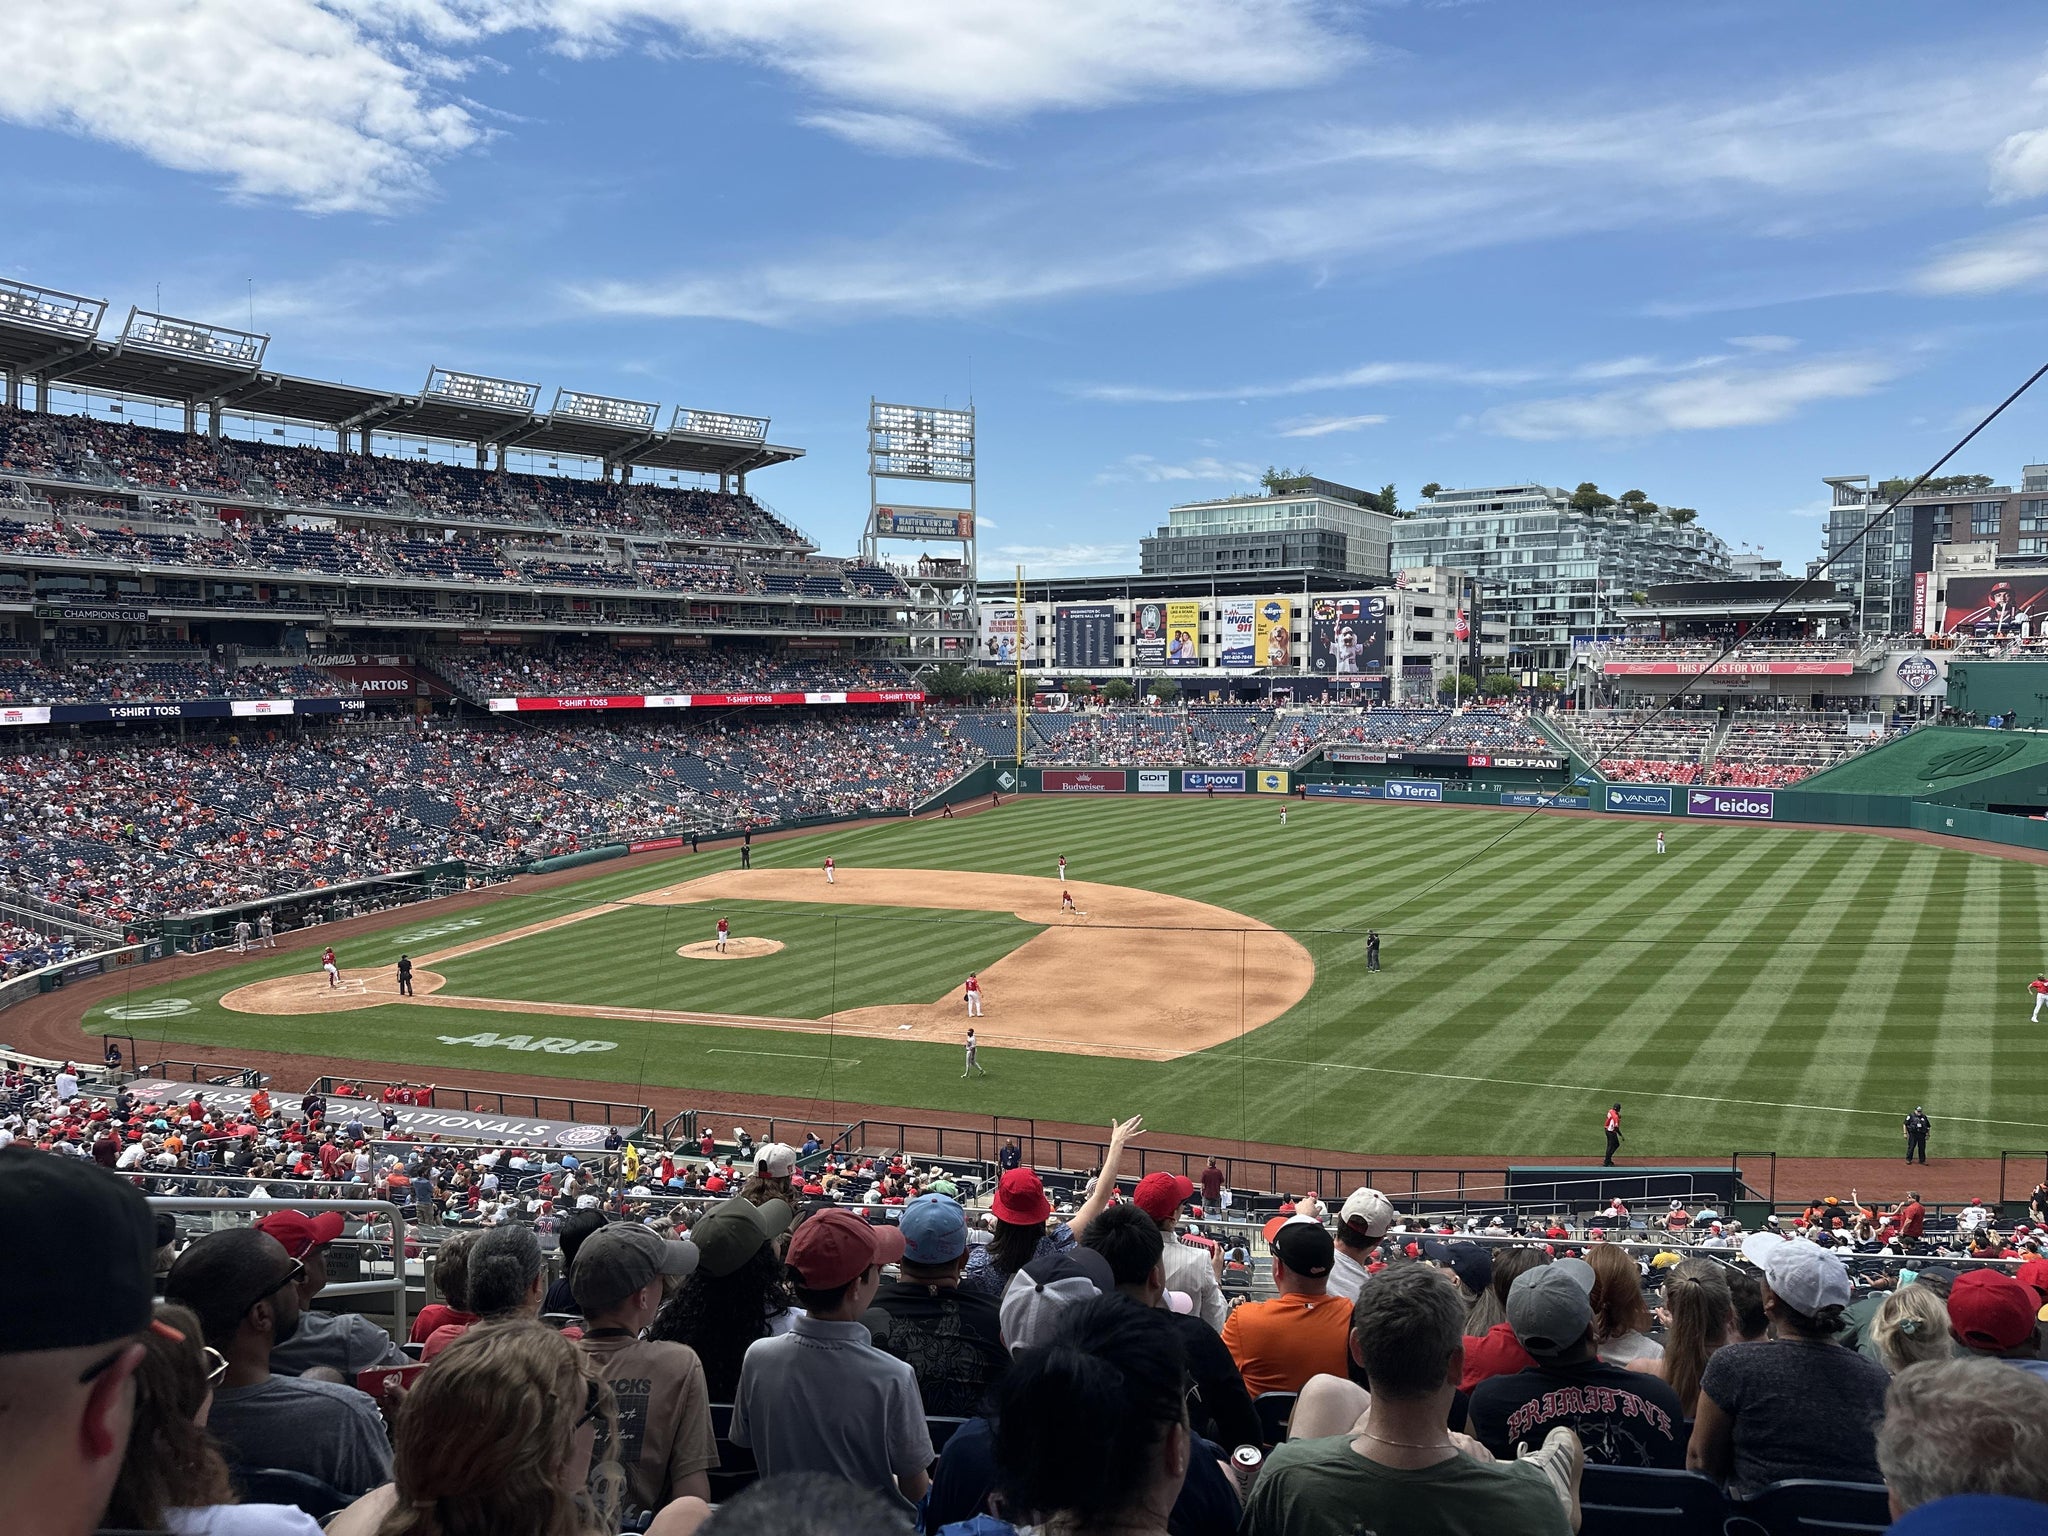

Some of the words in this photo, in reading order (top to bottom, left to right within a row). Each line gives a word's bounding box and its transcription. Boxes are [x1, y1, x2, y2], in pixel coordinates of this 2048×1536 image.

[898, 517, 925, 527] BEAUTIFUL
[926, 519, 942, 527] VIEWS
[942, 520, 953, 528] AND
[896, 525, 915, 533] AWARD
[915, 526, 938, 535] WINNING
[938, 527, 956, 536] BREWS
[1915, 584, 1924, 605] TEAM
[64, 609, 120, 620] CHAMPIONS
[122, 610, 146, 620] CLUB
[1227, 615, 1253, 624] HVAC
[1915, 606, 1924, 630] STORE
[1237, 624, 1252, 632] 911
[1676, 664, 1697, 673] THIS
[1729, 664, 1748, 673] FOR
[1750, 663, 1772, 673] YOU.
[361, 680, 409, 690] ARTOIS
[754, 695, 773, 703] TOSS
[879, 693, 903, 701] T-SHIRT
[557, 699, 587, 708] T-SHIRT
[589, 699, 608, 707] TOSS
[109, 706, 152, 717] T-SHIRT
[153, 706, 181, 716] TOSS
[1338, 753, 1361, 761] Harris
[1360, 754, 1385, 762] Teeter
[1471, 756, 1487, 766] 2:59
[1526, 759, 1558, 768] FAN
[1204, 774, 1238, 784] Inova
[1062, 782, 1105, 791] Budweiser
[1403, 785, 1438, 797] Terra
[1623, 794, 1667, 803] VANDA
[1715, 797, 1770, 814] leidos
[436, 1032, 619, 1055] AARP
[175, 1088, 380, 1120] WASHNGON
[539, 1220, 553, 1237] 24
[1506, 1385, 1674, 1445] PRIMITIVE
